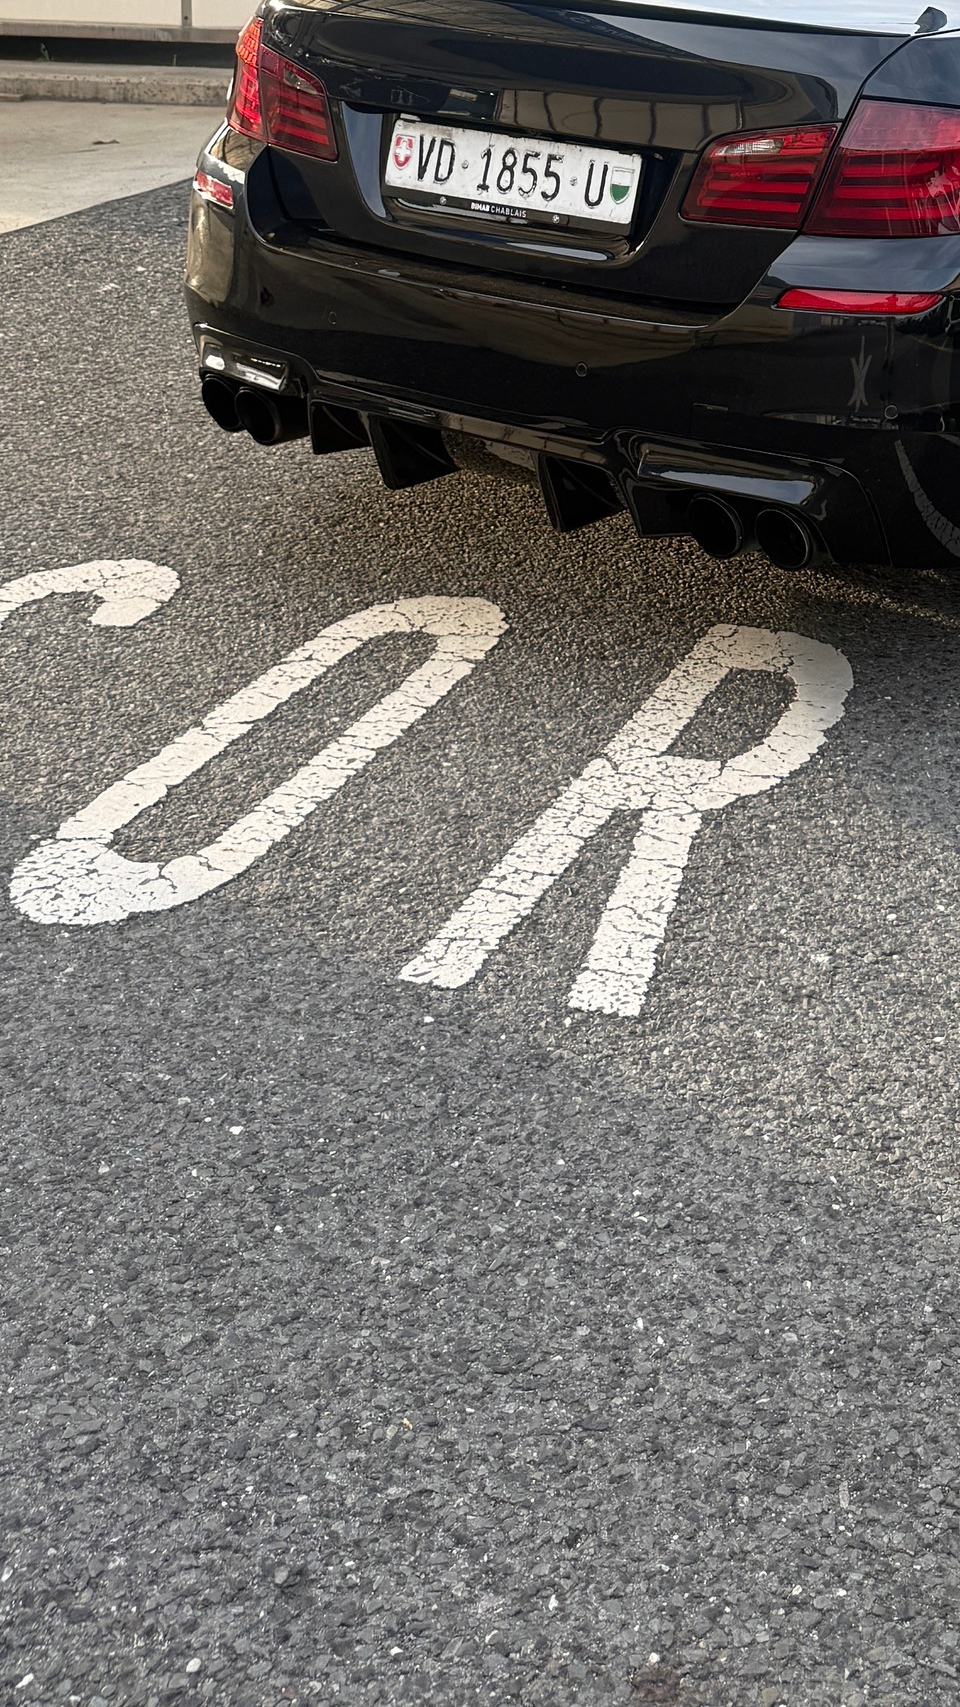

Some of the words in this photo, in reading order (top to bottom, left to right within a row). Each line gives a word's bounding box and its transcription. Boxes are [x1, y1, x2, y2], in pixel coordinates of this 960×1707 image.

[416, 133, 456, 184] VD
[476, 147, 565, 202] 1855
[583, 159, 610, 209] U
[490, 205, 527, 218] CHABLAIS
